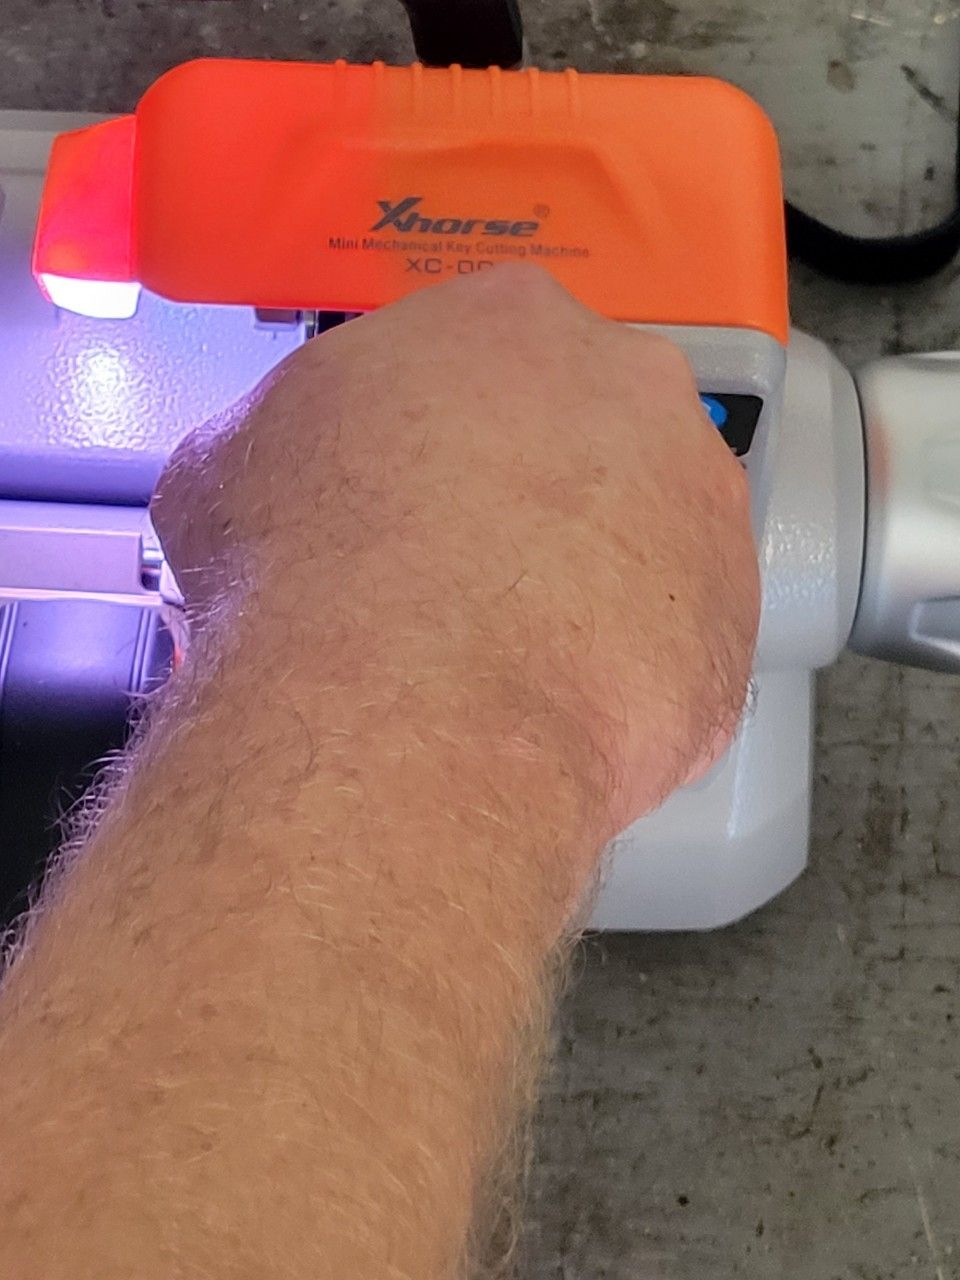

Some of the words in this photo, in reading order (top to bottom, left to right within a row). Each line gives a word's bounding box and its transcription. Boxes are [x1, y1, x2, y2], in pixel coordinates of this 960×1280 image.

[370, 196, 539, 237] Xhorse
[328, 237, 358, 250] Mini
[362, 238, 442, 252] Mechanical
[446, 241, 470, 254] Key
[476, 242, 526, 257] Cutting
[530, 244, 589, 258] Machine
